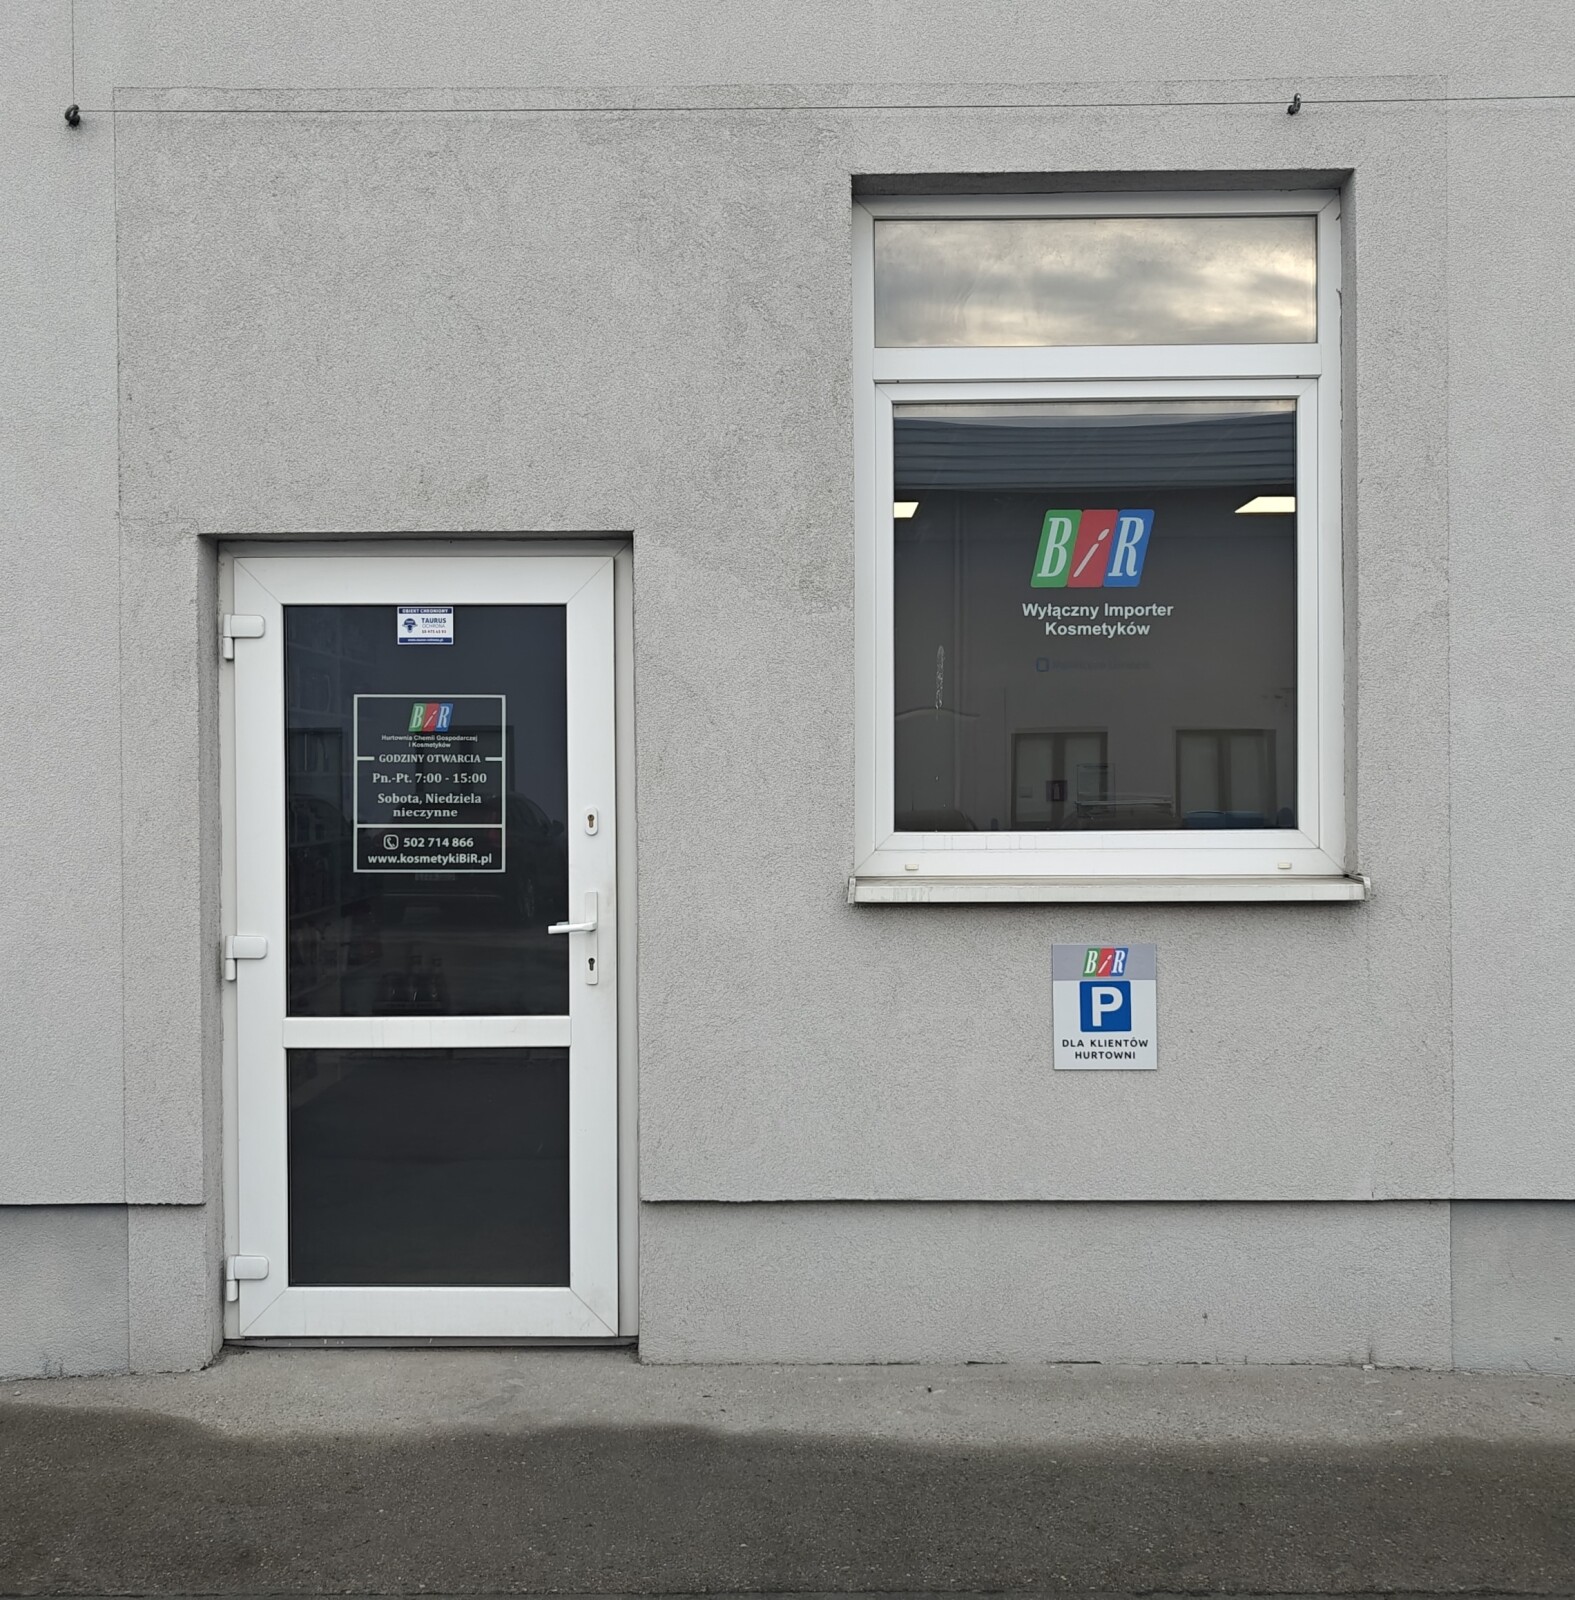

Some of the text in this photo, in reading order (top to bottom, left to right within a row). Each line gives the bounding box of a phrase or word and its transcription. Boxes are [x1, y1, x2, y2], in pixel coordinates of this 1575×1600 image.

[1037, 517, 1144, 577] BiR
[1022, 603, 1174, 619] Wyłączny Importer
[1045, 621, 1150, 638] Kosmetyków
[410, 705, 450, 729] BiR
[436, 734, 478, 742] Gospodarczej
[379, 754, 481, 763] GODZINY OTWARCIA
[372, 773, 412, 783] Pn.-Pt.
[415, 773, 442, 783] 7:00
[453, 773, 487, 783] 15:00
[377, 793, 482, 805] Sobota, Niedziela
[393, 807, 458, 819] nieczynne
[403, 838, 474, 848] 502 714 866
[368, 853, 492, 866] www.kosmetykiBiR.pl
[1084, 950, 1125, 973] BiR
[1092, 986, 1123, 1027] P
[1062, 1036, 1148, 1047] DLA KLIENTÓW
[1075, 1051, 1135, 1059] HURTOWNI
